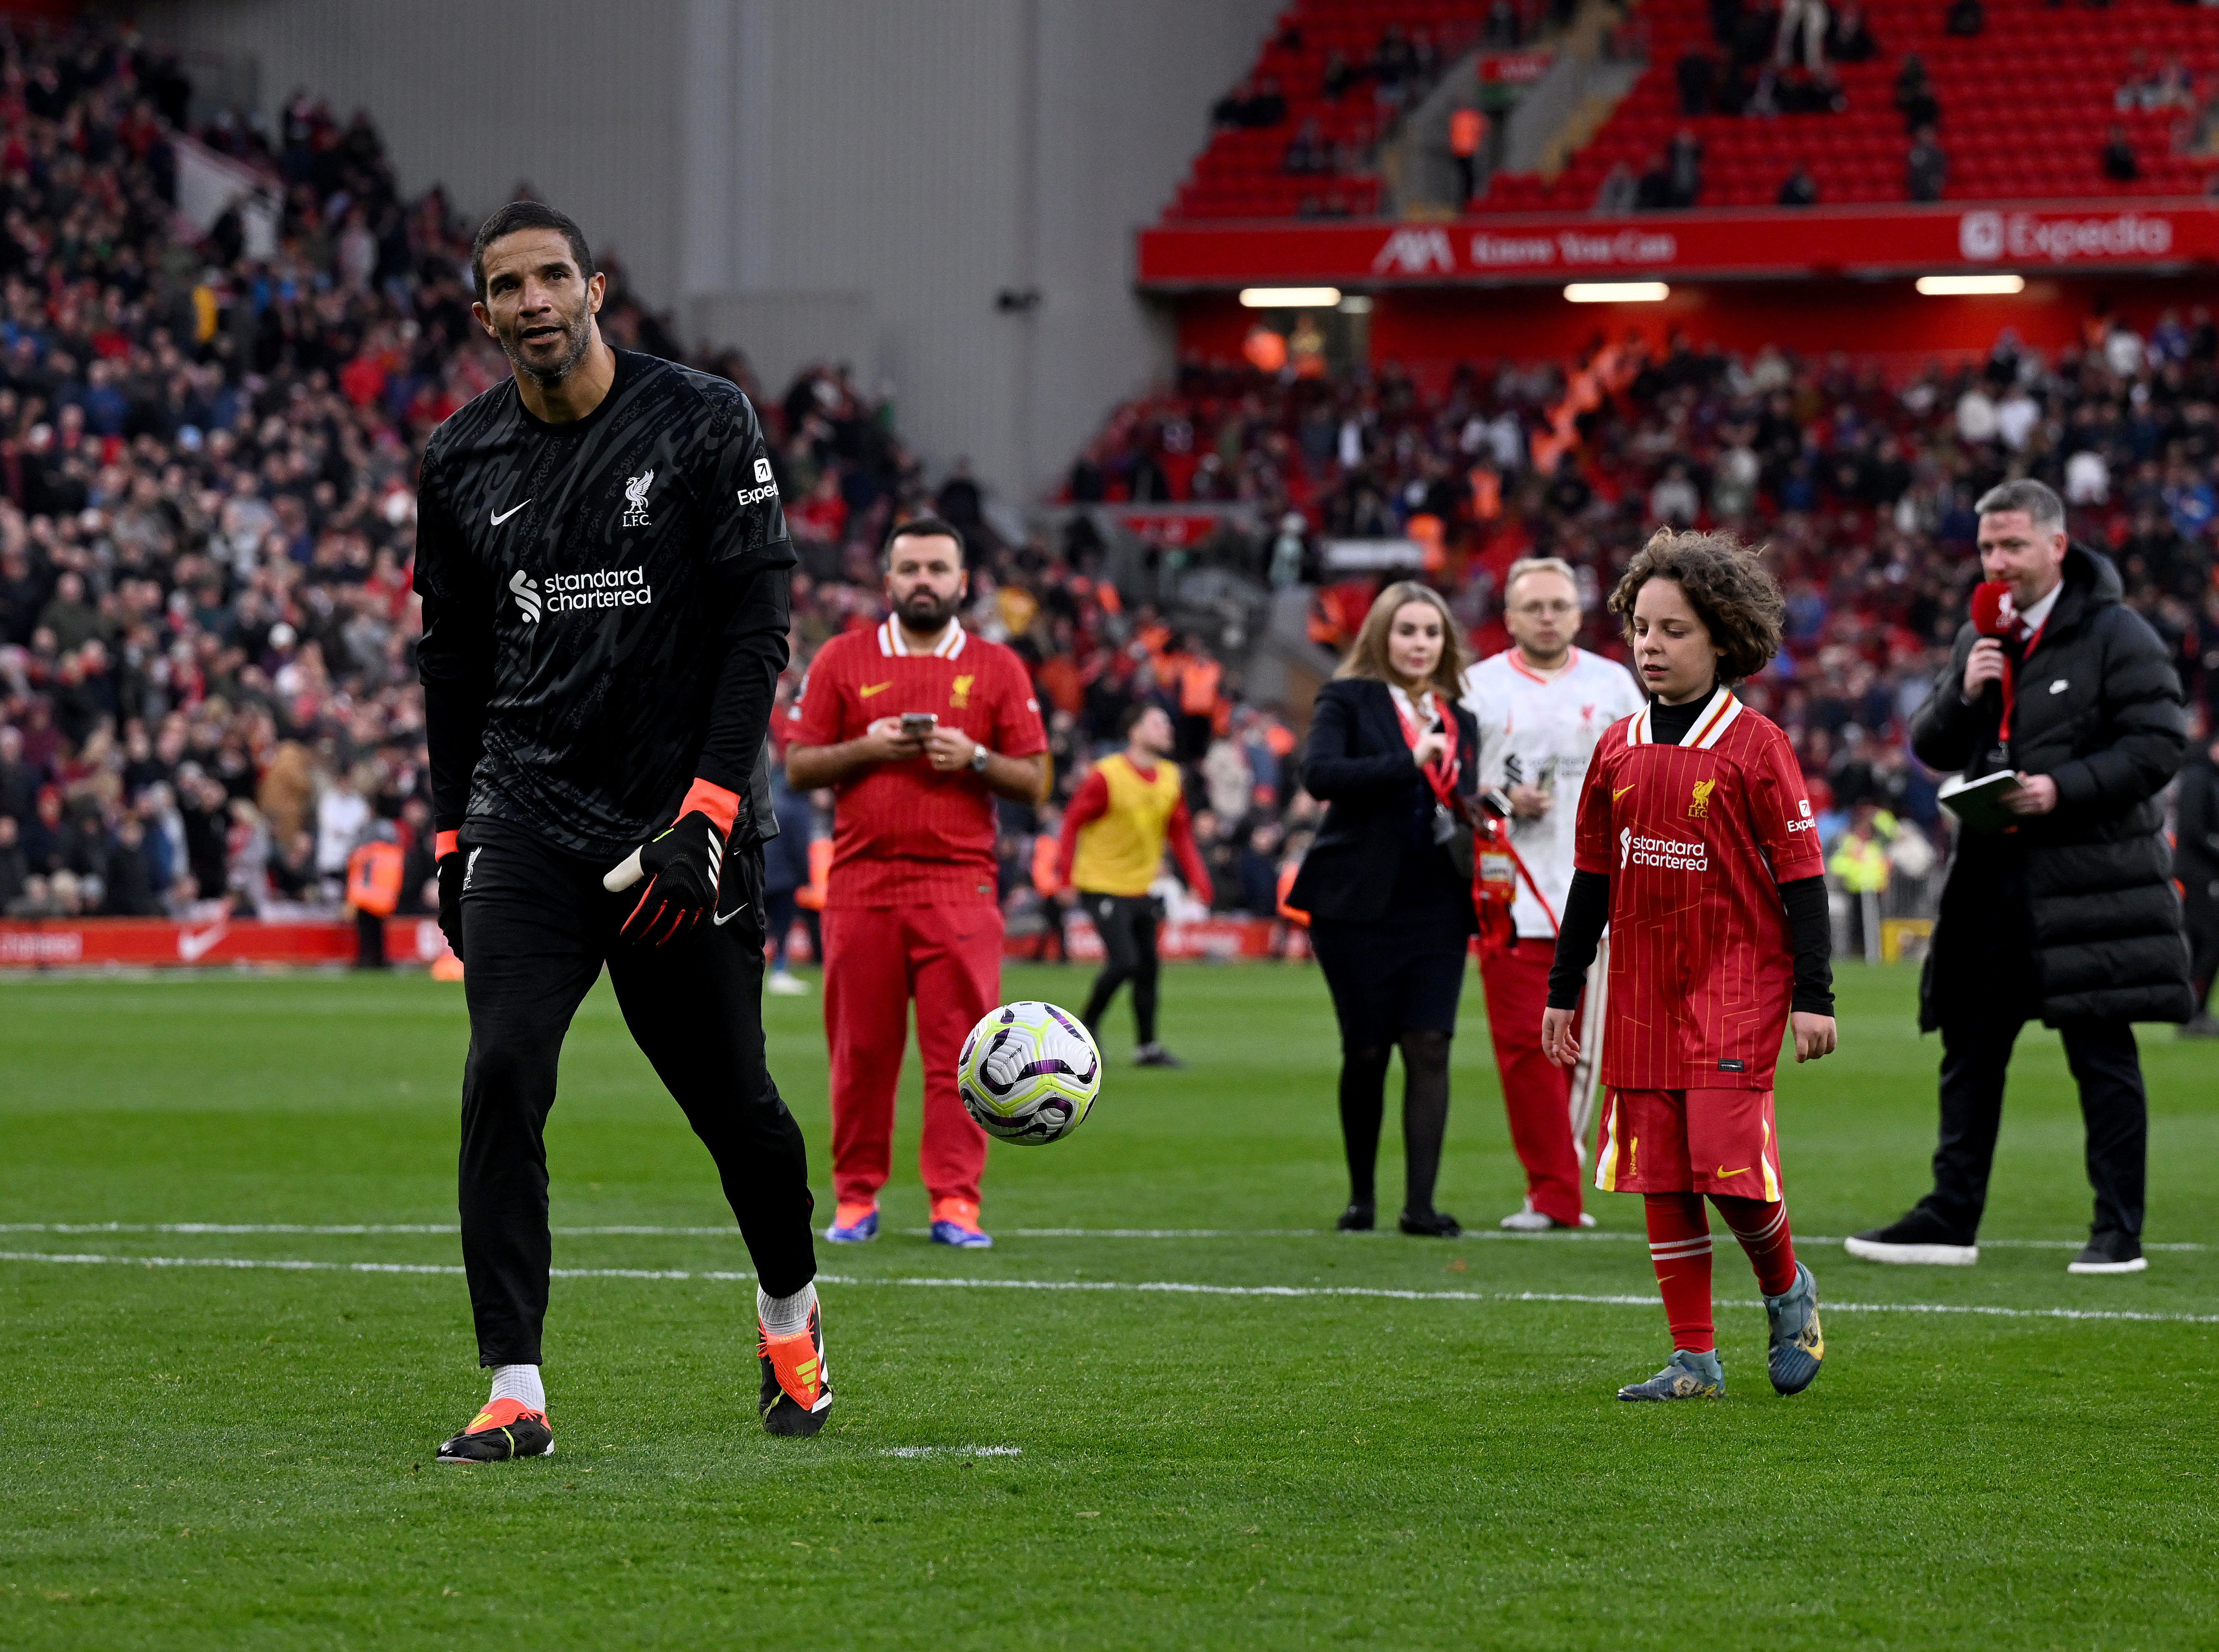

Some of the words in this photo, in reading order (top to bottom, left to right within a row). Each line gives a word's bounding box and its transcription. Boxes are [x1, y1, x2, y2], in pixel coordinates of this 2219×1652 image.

[2006, 212, 2172, 263] Expedia
[622, 515, 652, 527] L.F.C.
[544, 566, 643, 593] standard
[547, 585, 651, 612] chartered
[1632, 835, 1705, 856] standard
[1632, 850, 1708, 871] chartered
